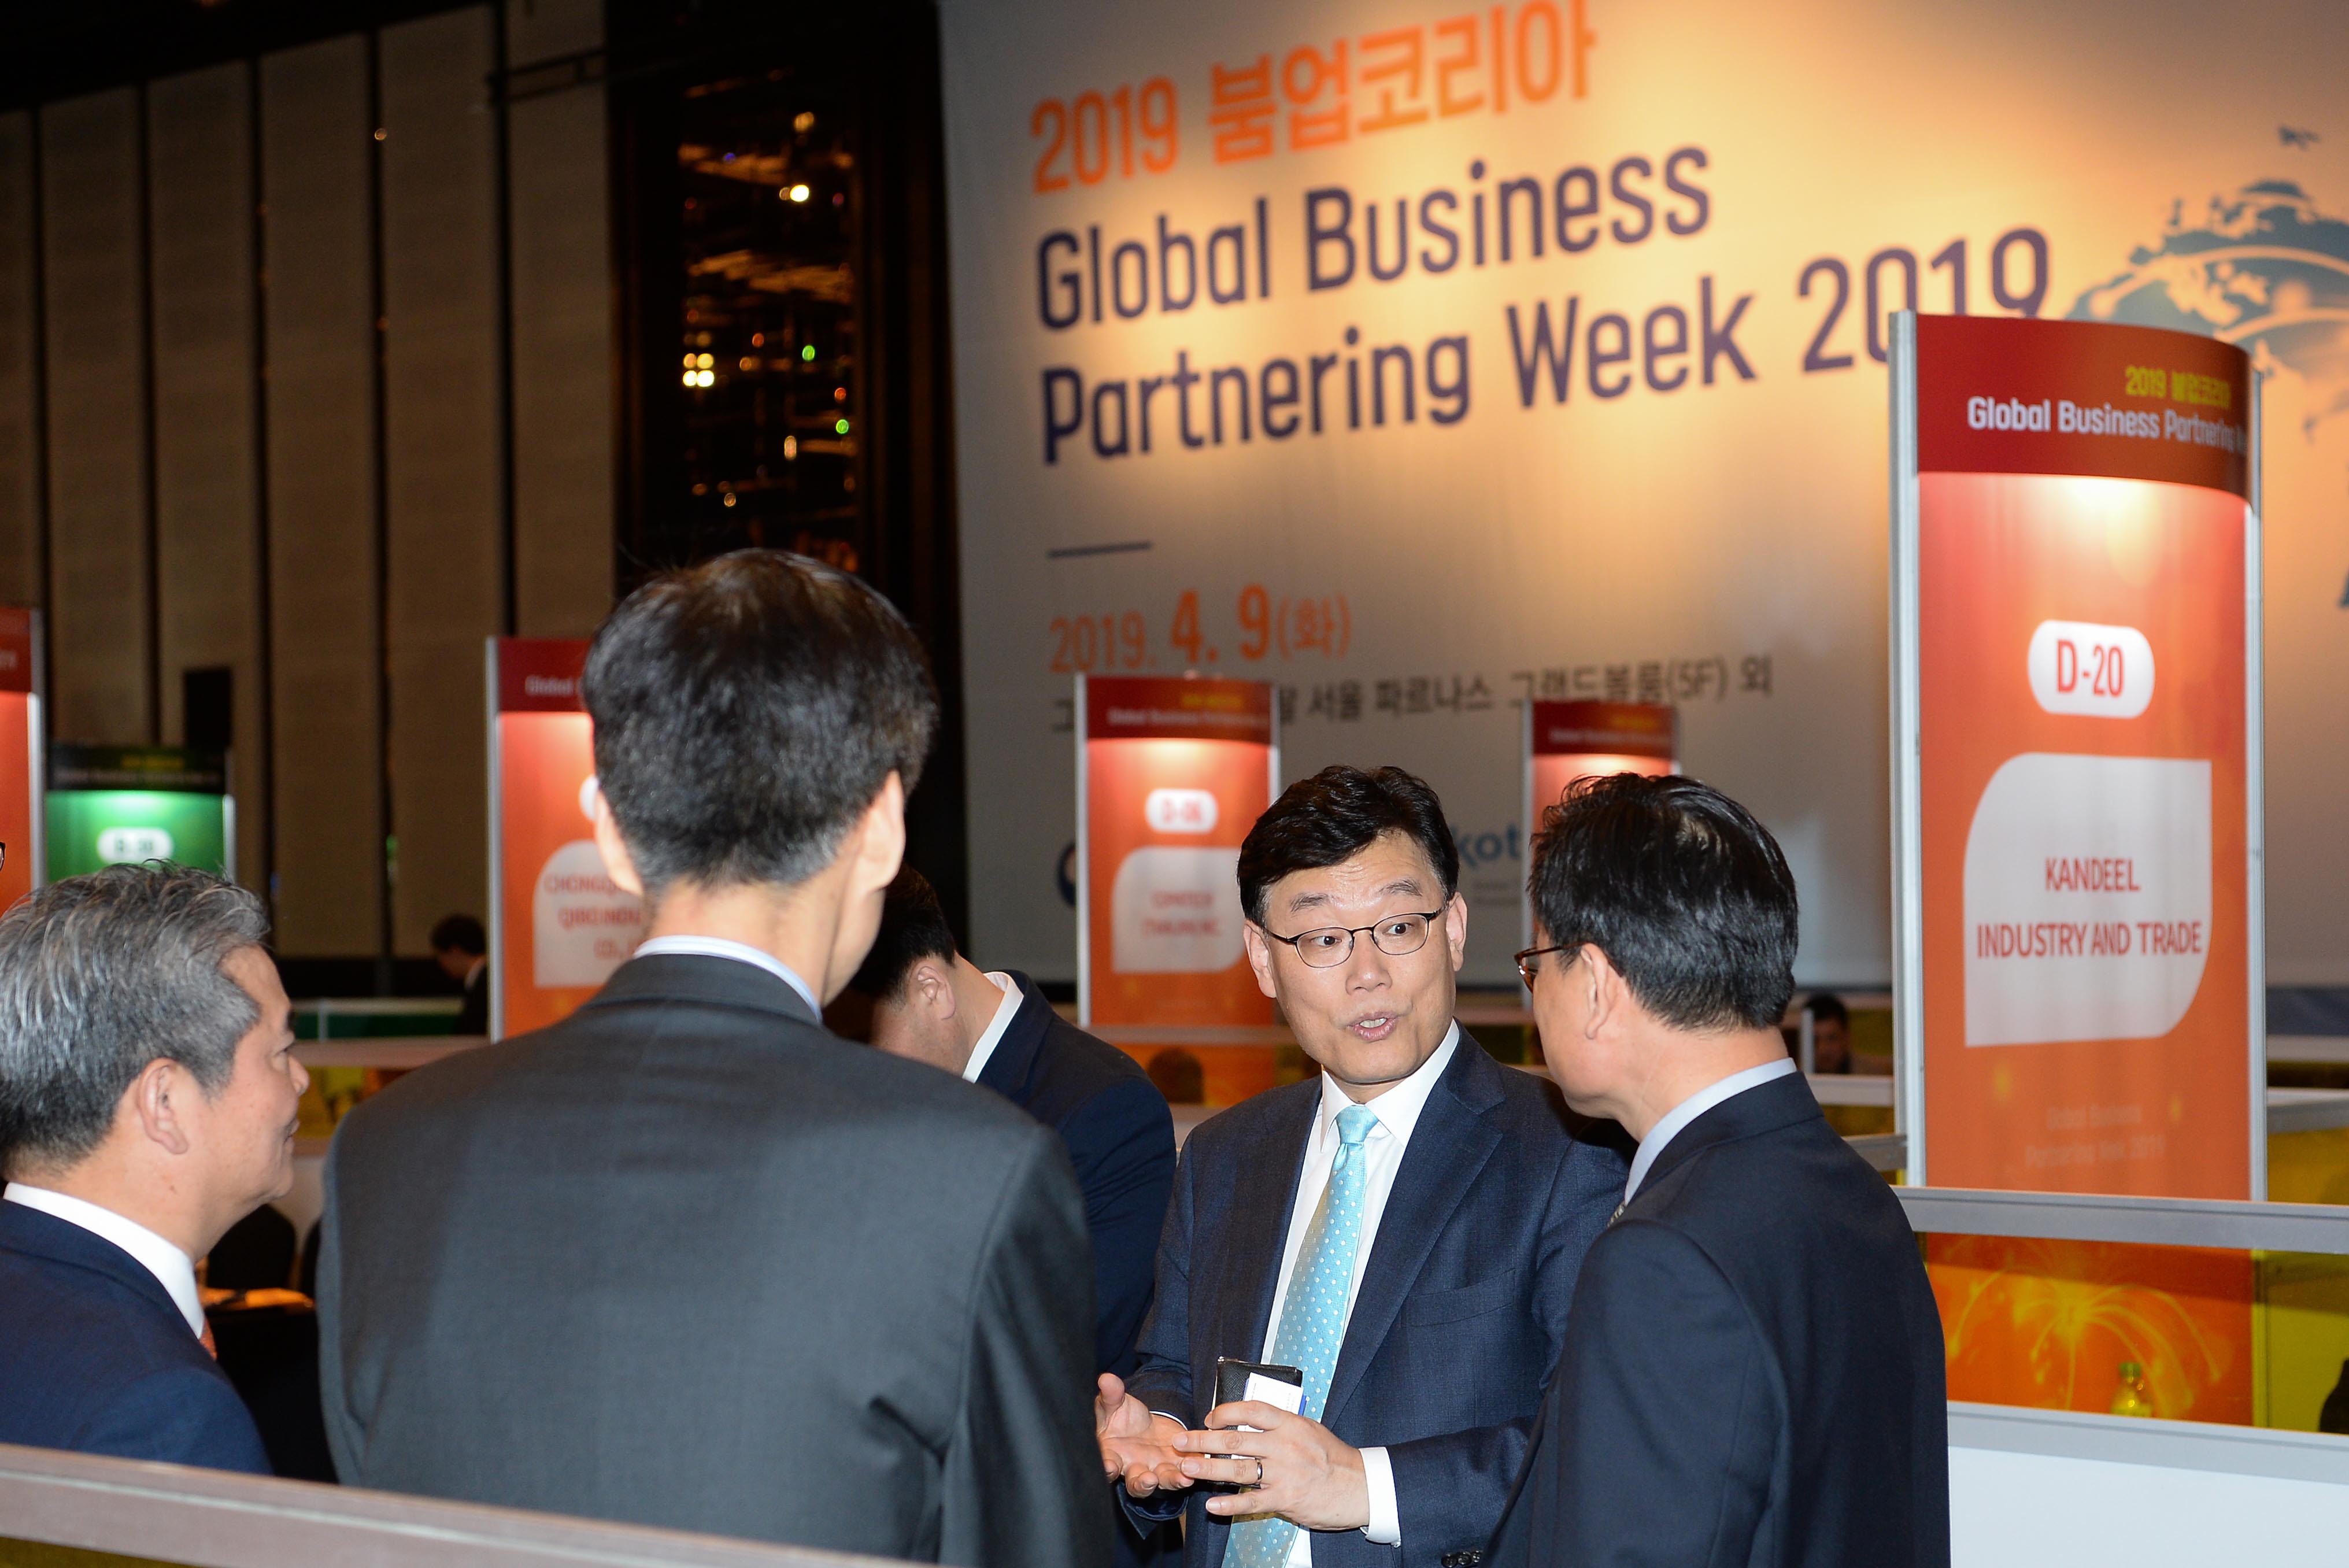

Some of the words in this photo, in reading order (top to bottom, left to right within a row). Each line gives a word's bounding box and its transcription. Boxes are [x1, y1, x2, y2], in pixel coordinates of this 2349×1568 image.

[1030, 75, 1178, 194] 2019
[1208, 0, 1596, 165] 붐업코리아
[1037, 195, 1270, 330] Global
[1306, 146, 1709, 292] Business
[1042, 326, 1471, 465] Partnering
[1506, 275, 1758, 408] Week
[2125, 365, 2166, 398] 2019
[1967, 395, 2051, 432] Global
[2058, 400, 2161, 440] Business
[1050, 611, 1156, 673] 2019.
[1169, 589, 1218, 664] 4.
[2056, 638, 2125, 698] D-20
[2044, 856, 2141, 892] KANDEEL
[1976, 923, 2087, 959] INDUSTRY
[2090, 922, 2132, 957] AND
[2136, 920, 2202, 956] TRADE
